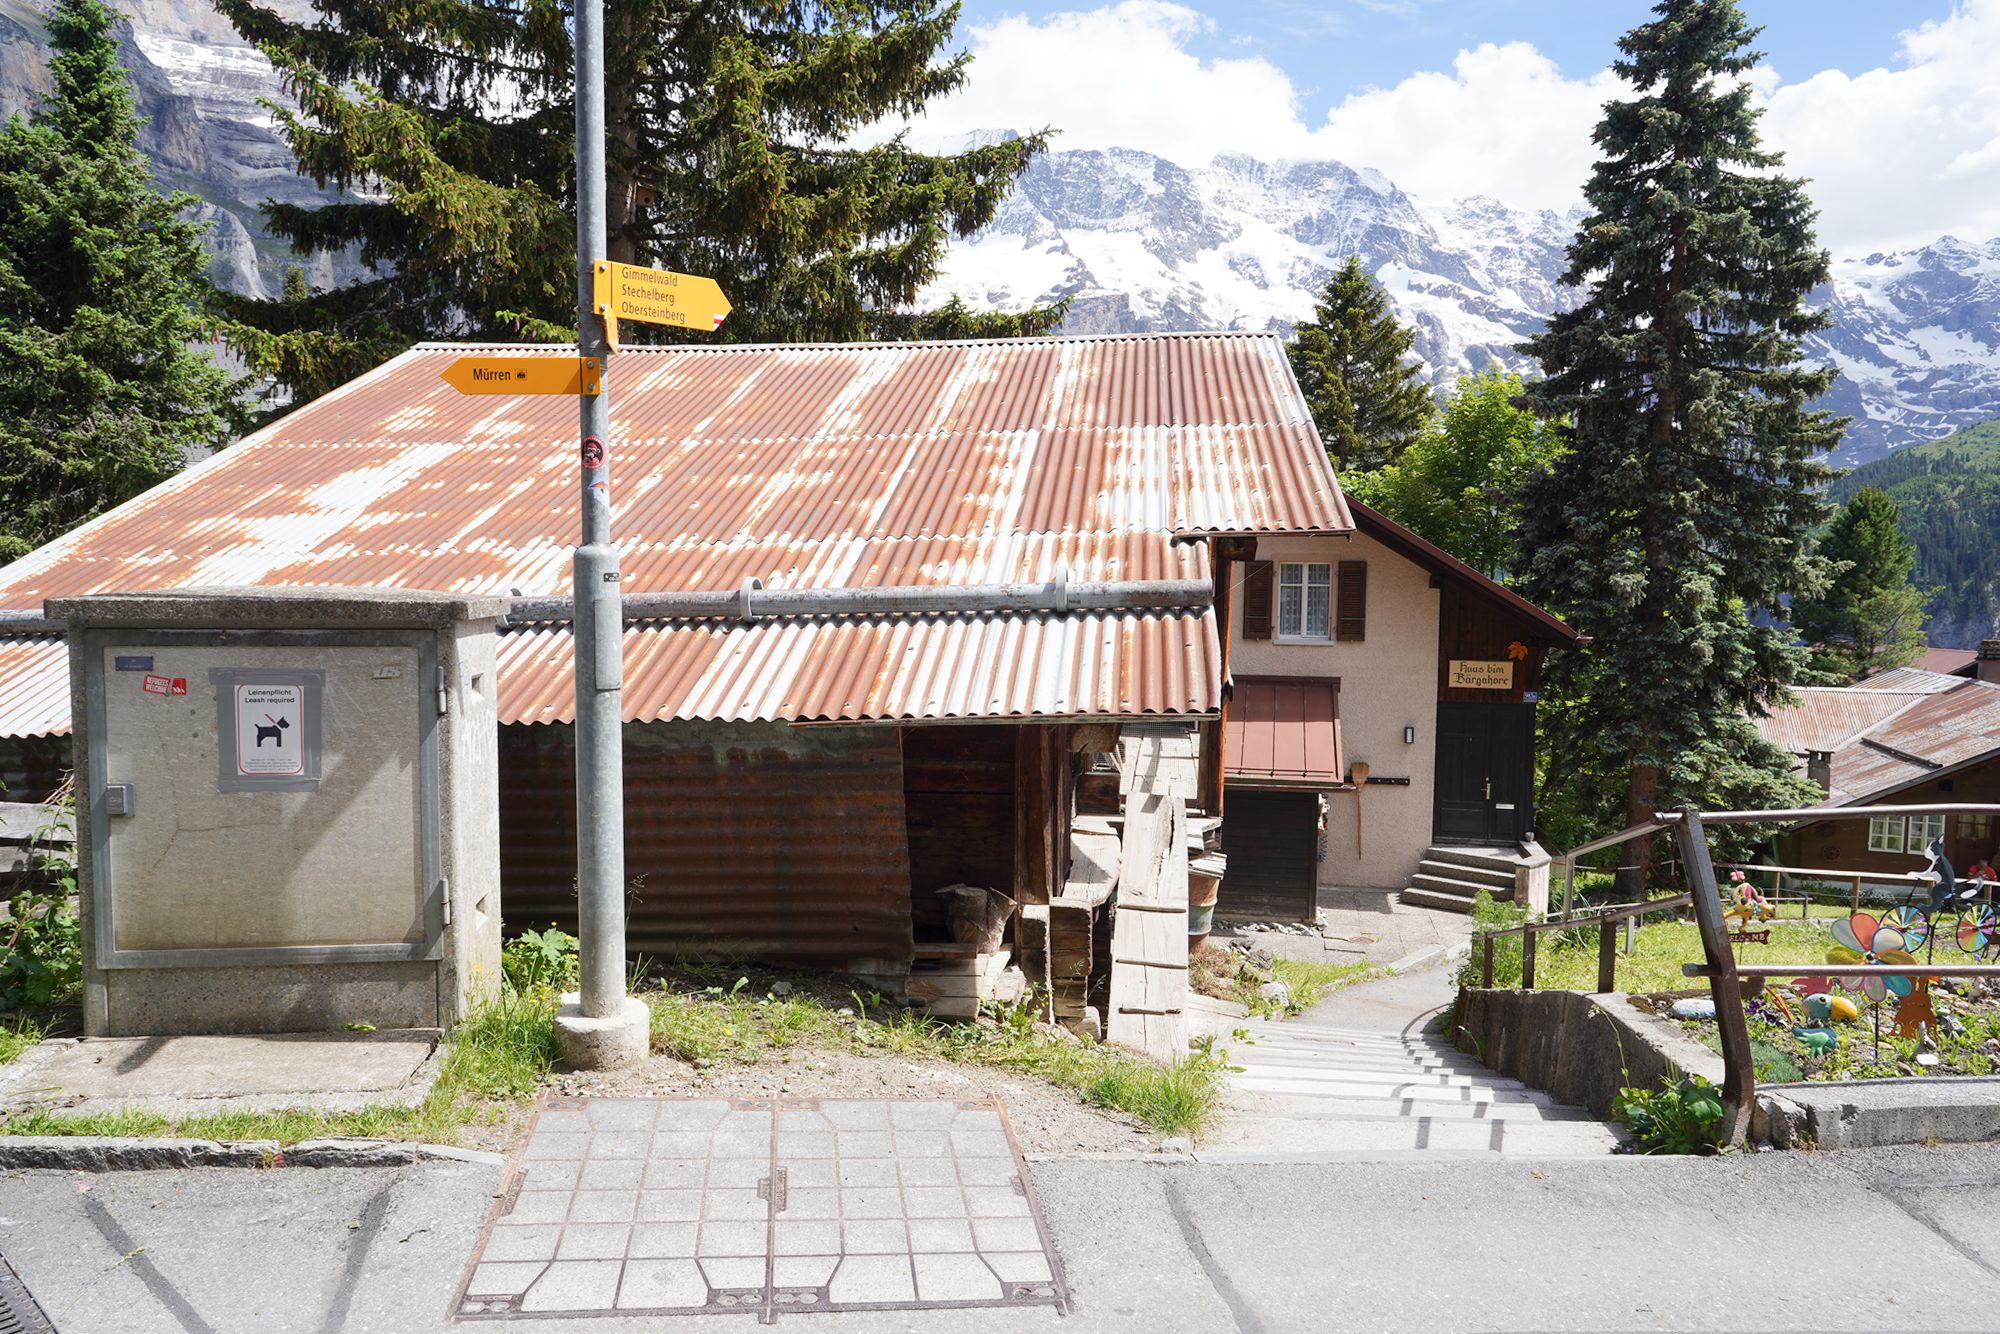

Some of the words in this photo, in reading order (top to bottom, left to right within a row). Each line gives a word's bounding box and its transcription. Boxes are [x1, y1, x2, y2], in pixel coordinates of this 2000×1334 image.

[621, 266, 678, 288] Gimmelwald
[621, 284, 675, 306] Stechelberg
[621, 302, 685, 324] Obersteinberg
[473, 367, 511, 381] Mürren
[1487, 664, 1504, 673] bim
